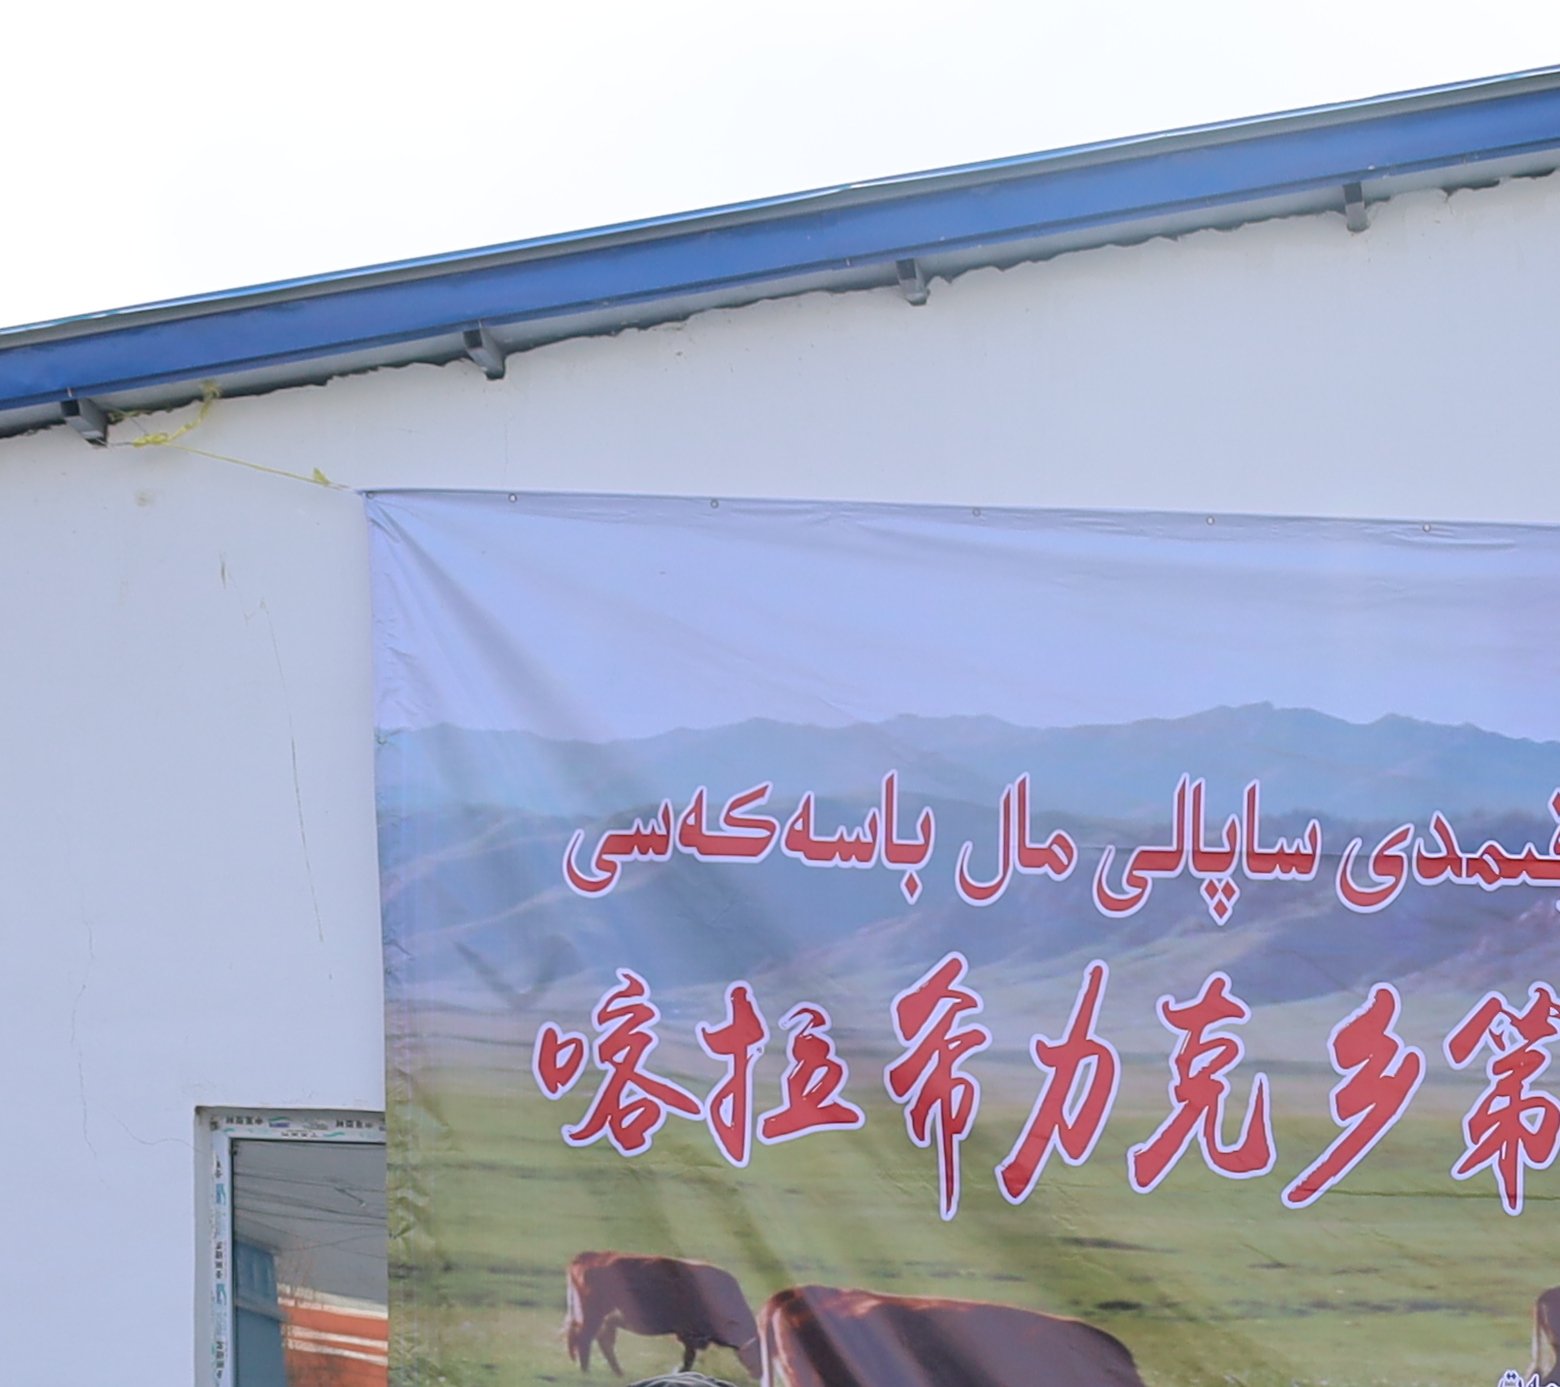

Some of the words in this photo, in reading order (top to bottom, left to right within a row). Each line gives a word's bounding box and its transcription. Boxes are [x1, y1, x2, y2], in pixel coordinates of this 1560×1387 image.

[564, 769, 935, 904] باسەكەسى
[955, 772, 1077, 906] مال
[1093, 772, 1320, 926] ساپالى
